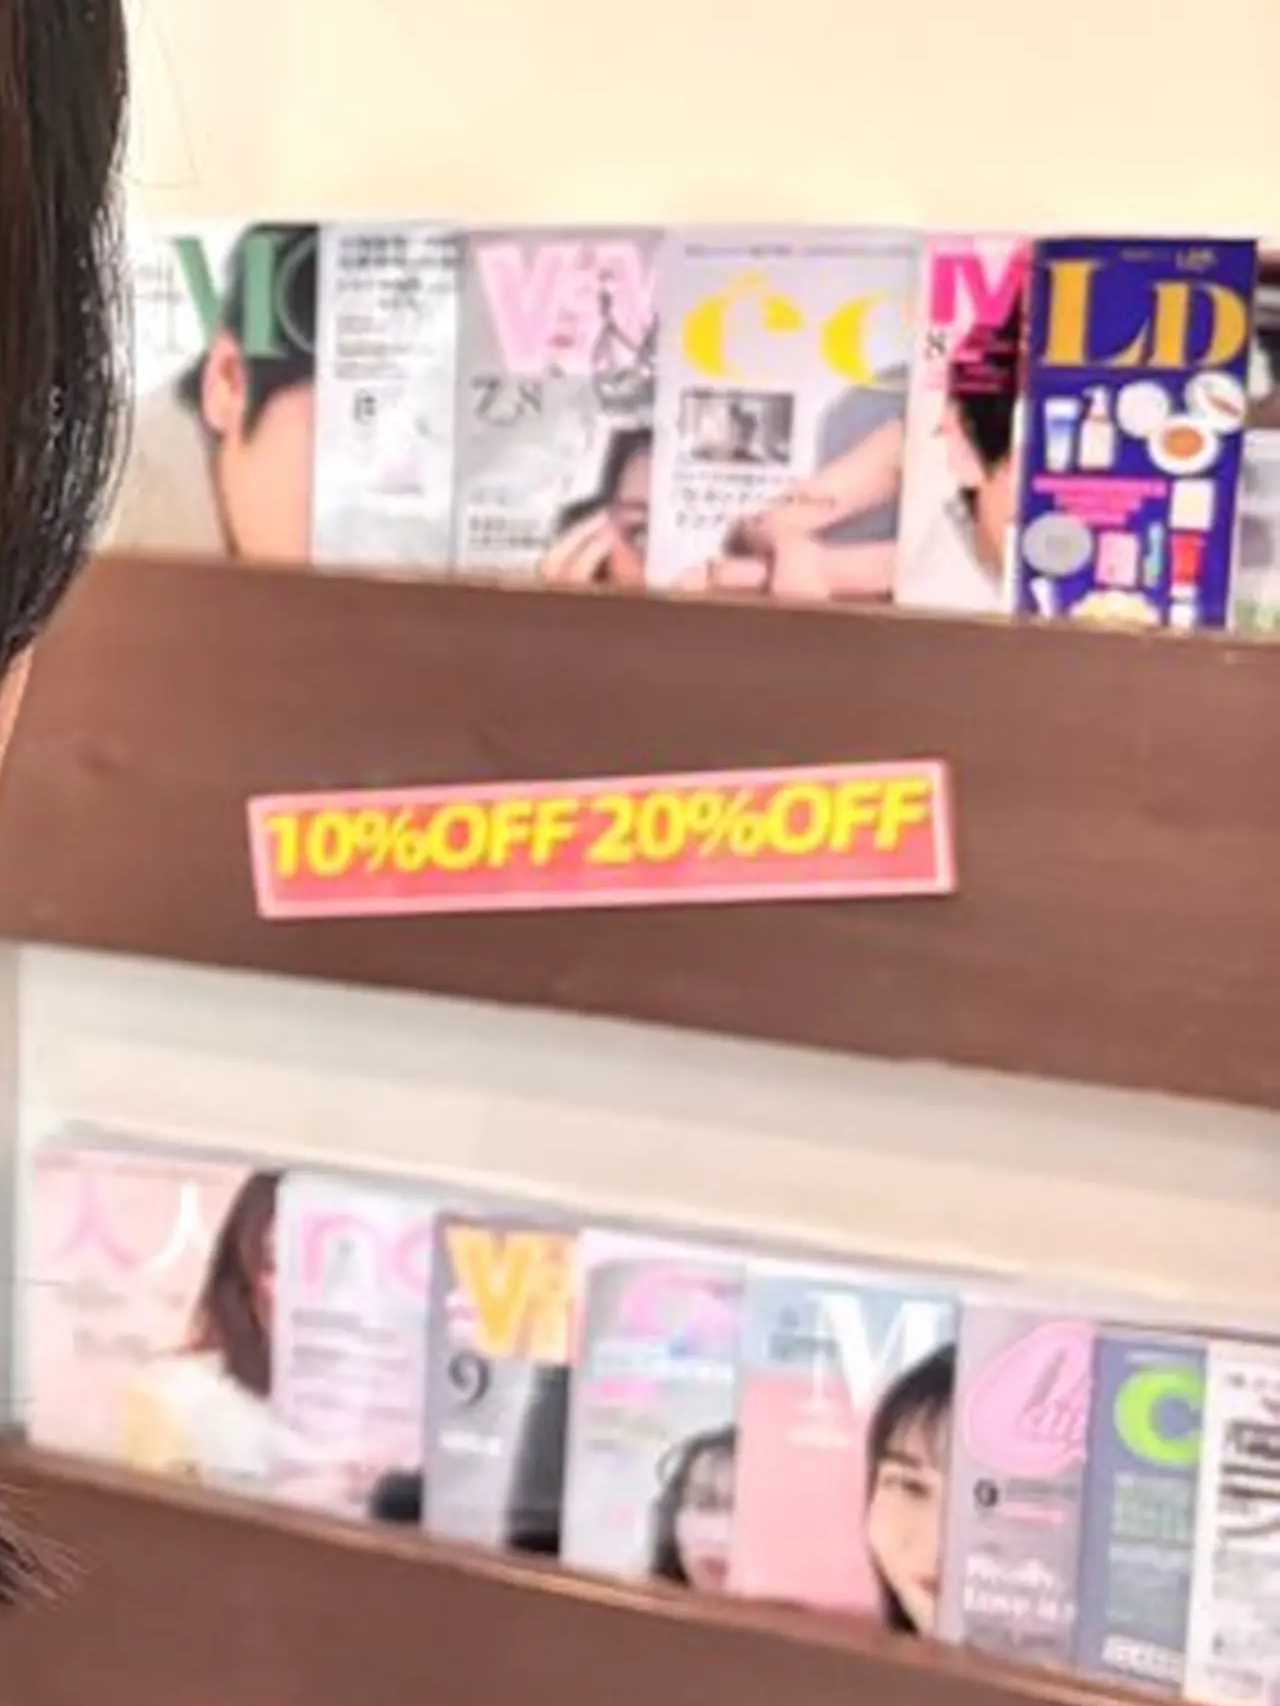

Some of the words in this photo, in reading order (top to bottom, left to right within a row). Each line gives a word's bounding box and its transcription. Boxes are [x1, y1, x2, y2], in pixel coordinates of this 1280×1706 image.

[1040, 257, 1249, 370] LD
[267, 795, 580, 878] 10%OFF
[584, 774, 928, 864] 20%OFF
